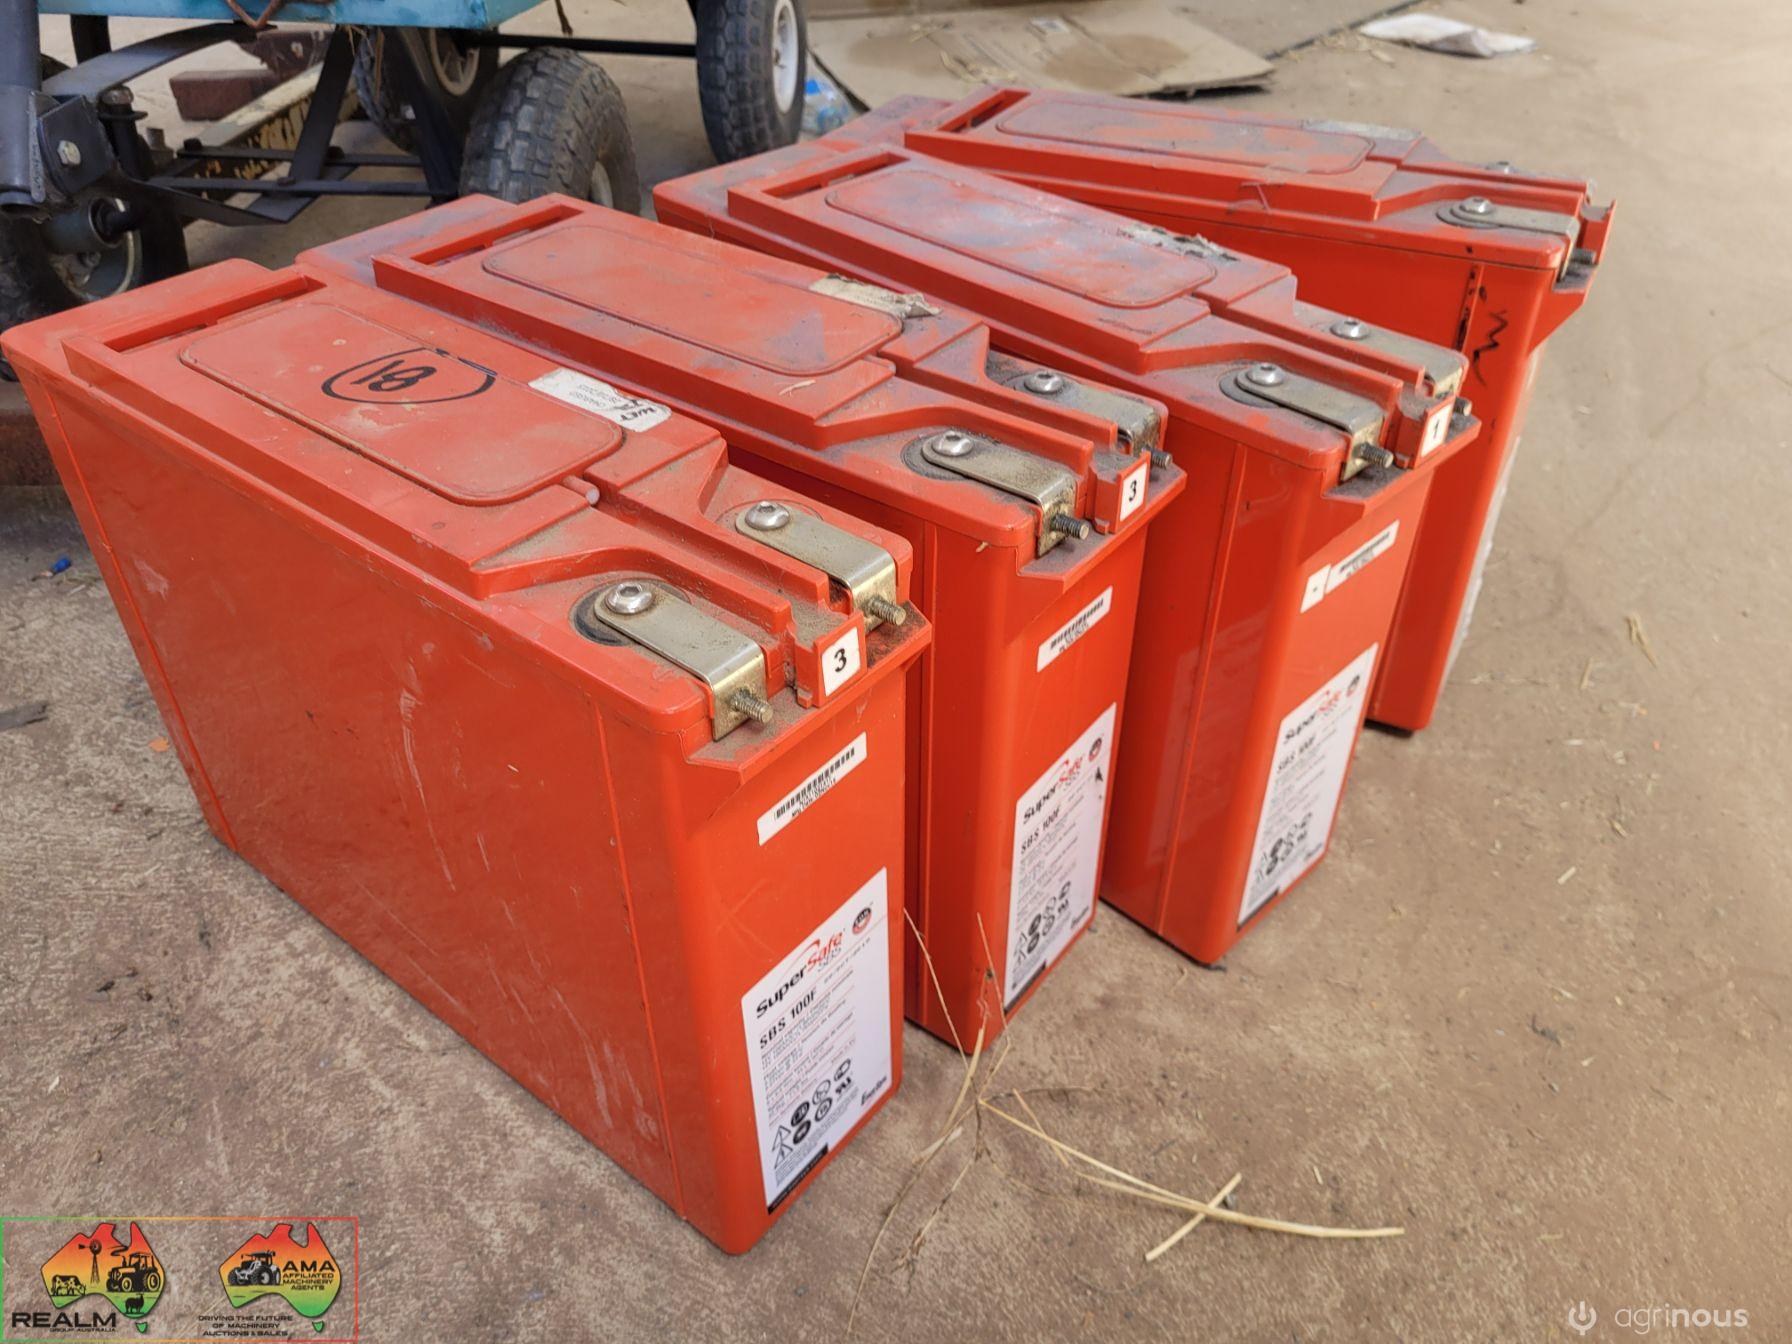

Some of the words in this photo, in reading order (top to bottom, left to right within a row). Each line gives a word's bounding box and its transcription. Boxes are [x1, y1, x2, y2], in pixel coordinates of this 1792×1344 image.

[1128, 479, 1138, 502] 3
[833, 647, 848, 673] 3
[756, 930, 844, 1019] SuperSafe
[760, 1017, 786, 1049] SBS
[791, 985, 816, 1020] 100F
